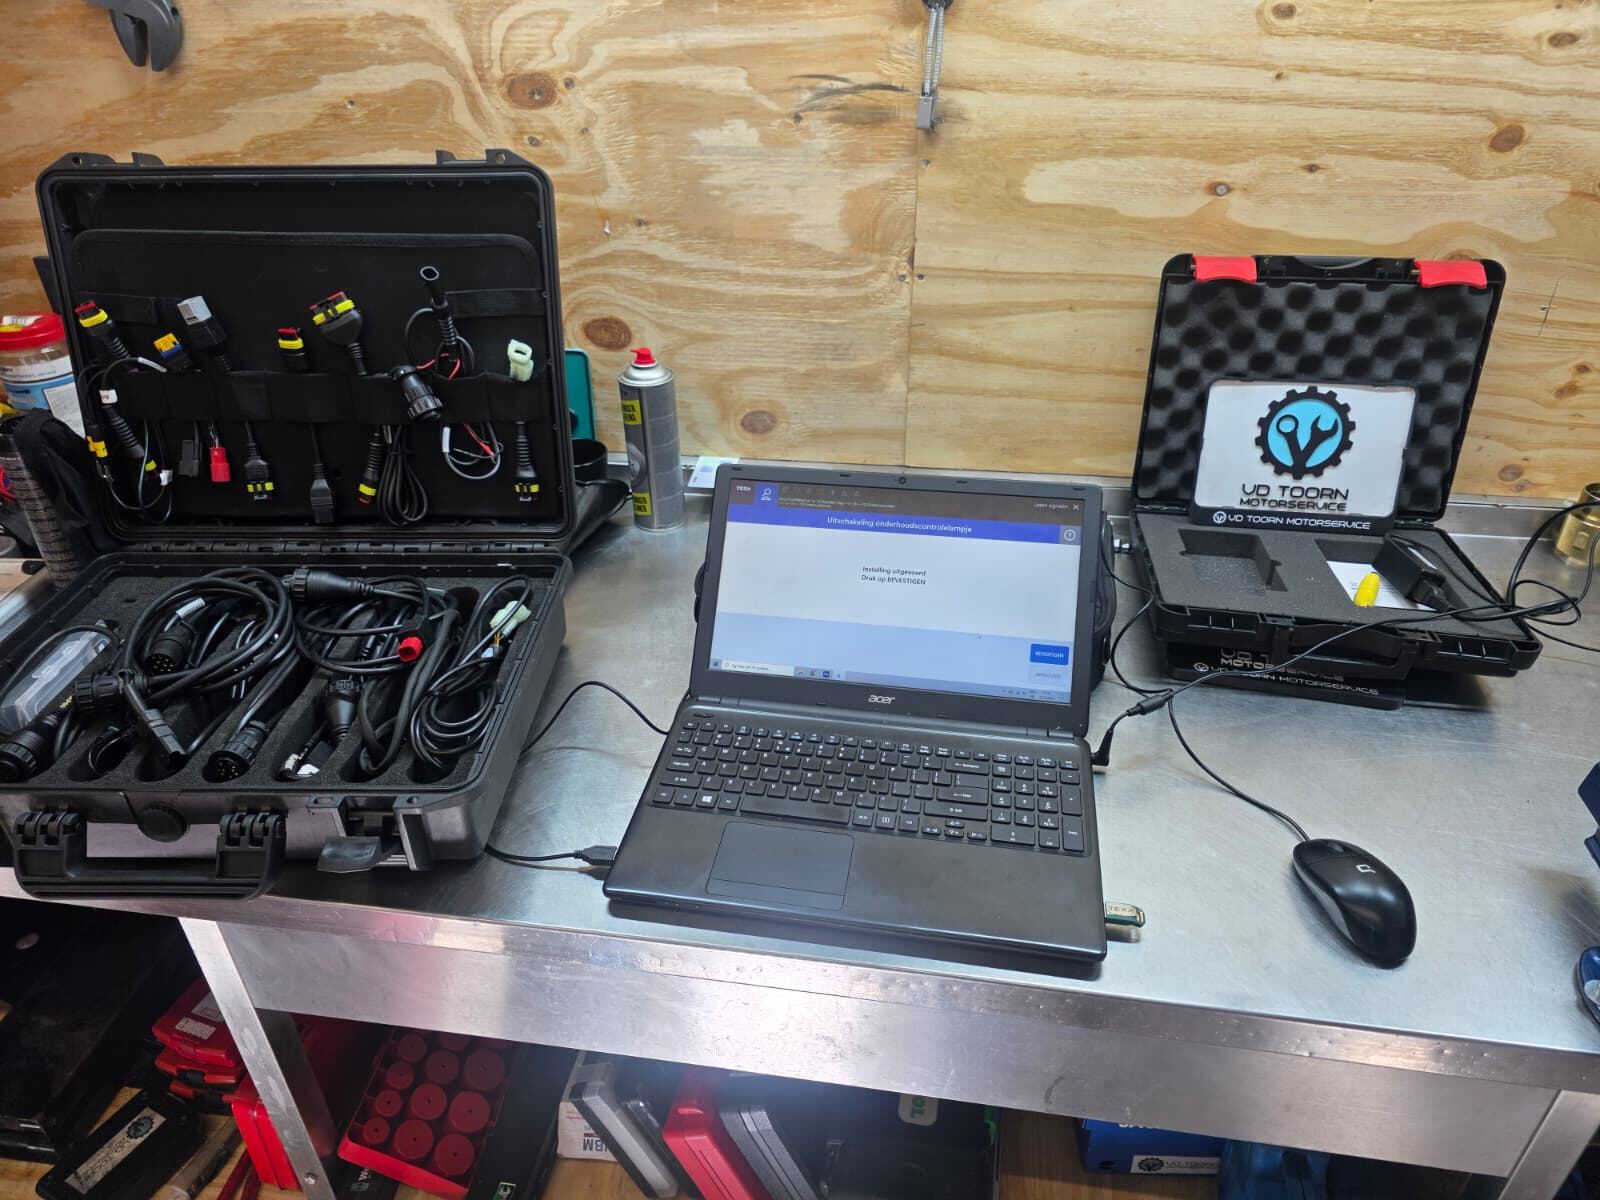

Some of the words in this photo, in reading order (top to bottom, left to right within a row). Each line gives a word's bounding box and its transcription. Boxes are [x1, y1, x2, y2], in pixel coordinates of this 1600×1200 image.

[1242, 483, 1271, 497] VD
[1278, 485, 1350, 501] TOORN
[1239, 497, 1347, 512] MOTORSERVICE
[827, 516, 874, 528] Uitschakeling
[1247, 515, 1284, 525] TOORN
[1286, 517, 1372, 530] MOTORSERVICE
[1278, 675, 1379, 696] MOTORSERVICE
[868, 694, 896, 705] acer
